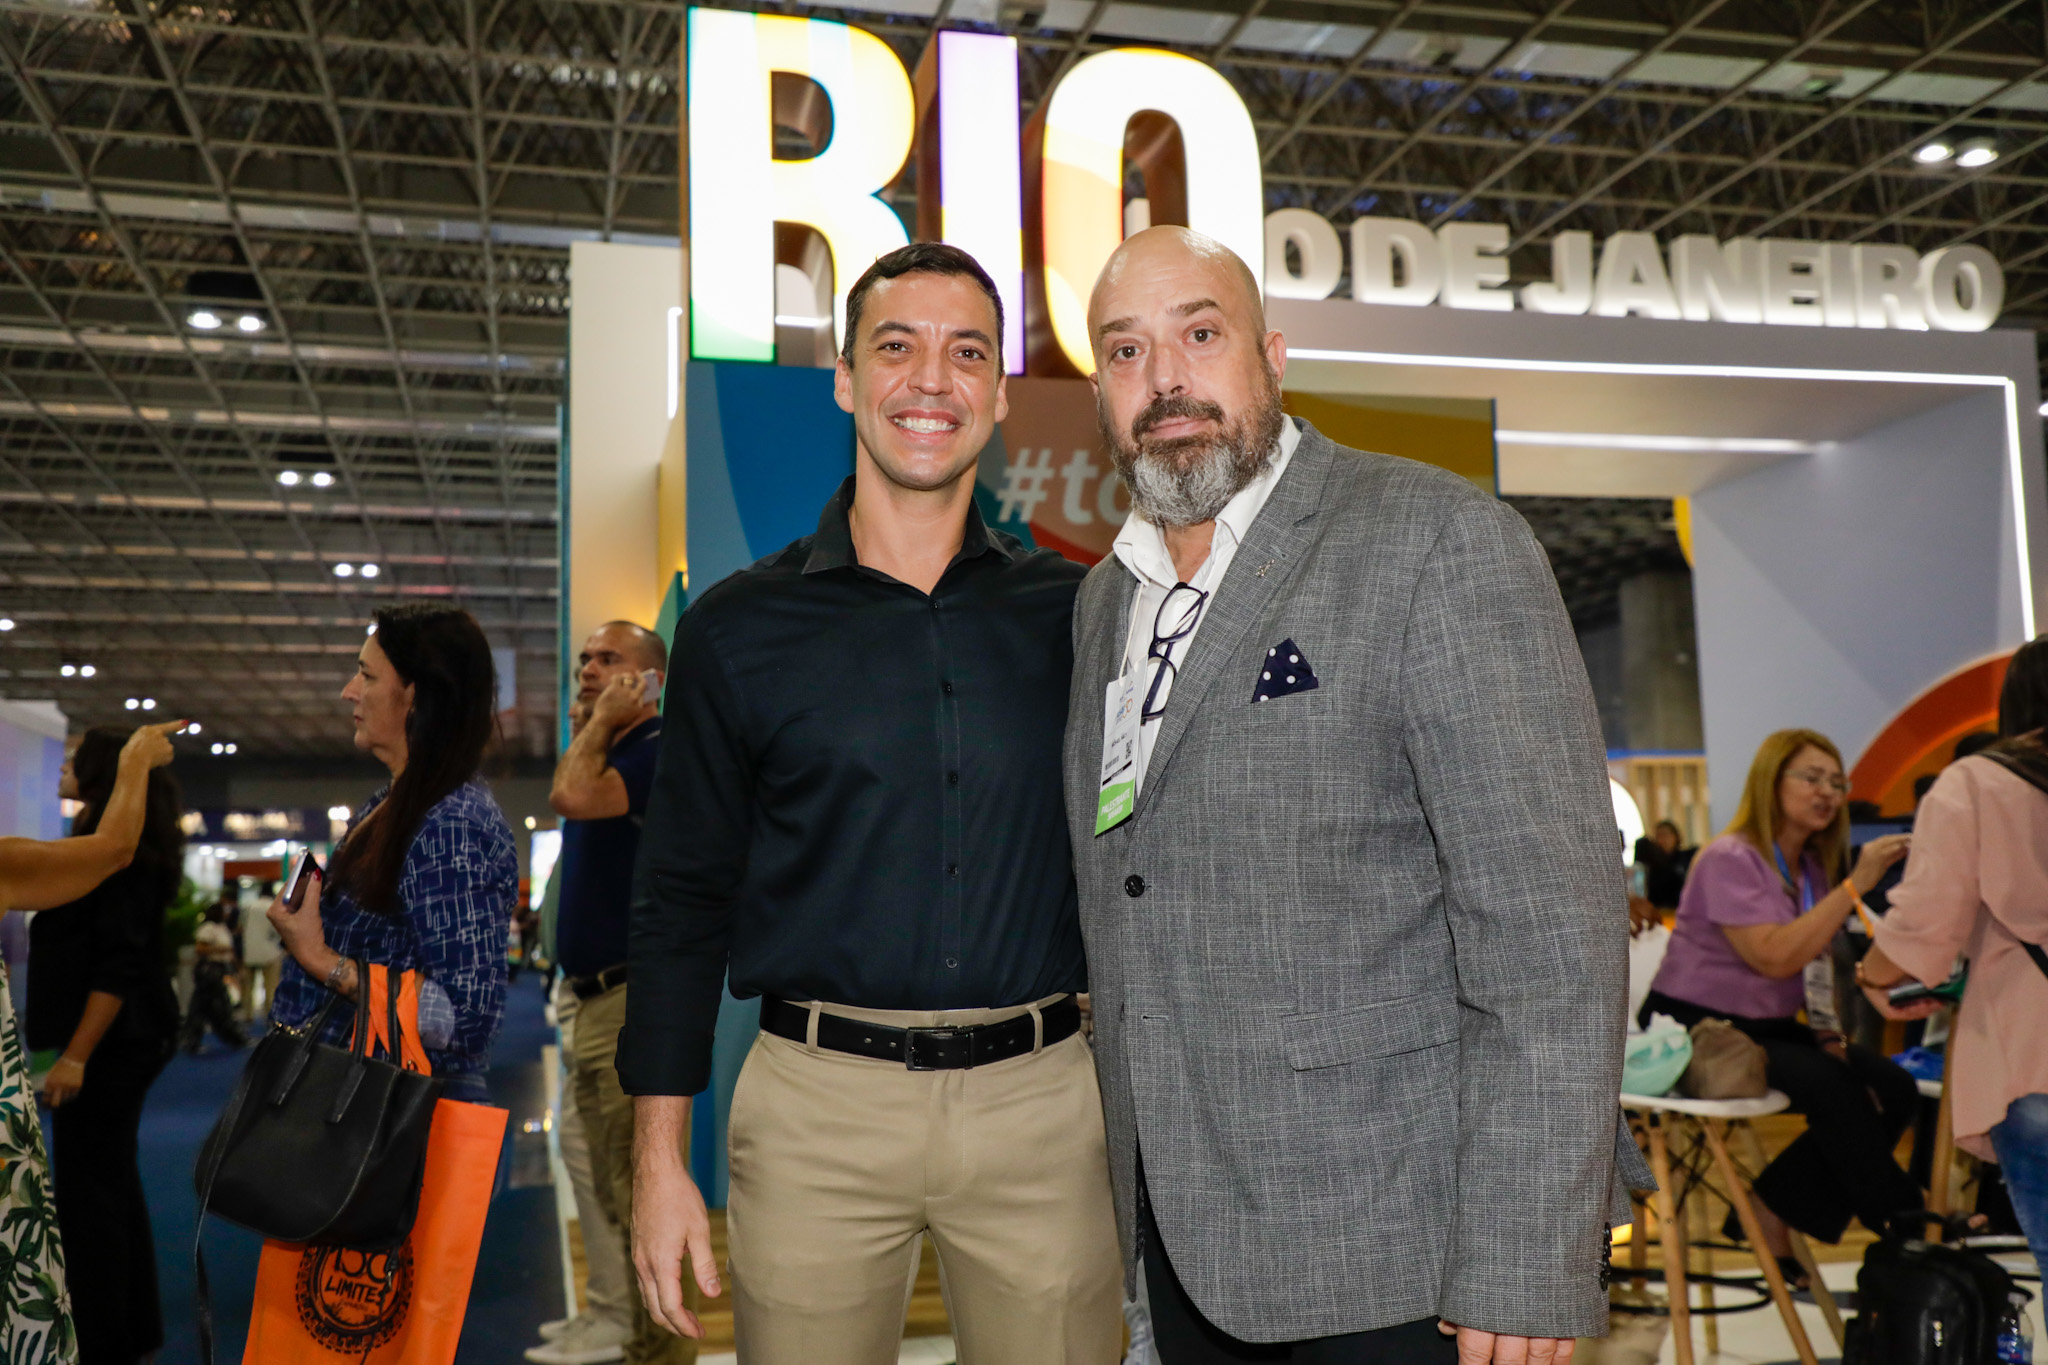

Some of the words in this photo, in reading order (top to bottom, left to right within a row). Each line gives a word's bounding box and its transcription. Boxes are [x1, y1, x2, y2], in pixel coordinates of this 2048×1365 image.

[686, 5, 1265, 377] RIO
[1351, 215, 1515, 312] DE
[1520, 229, 2005, 333] JANEIRO
[995, 447, 1133, 526] #to
